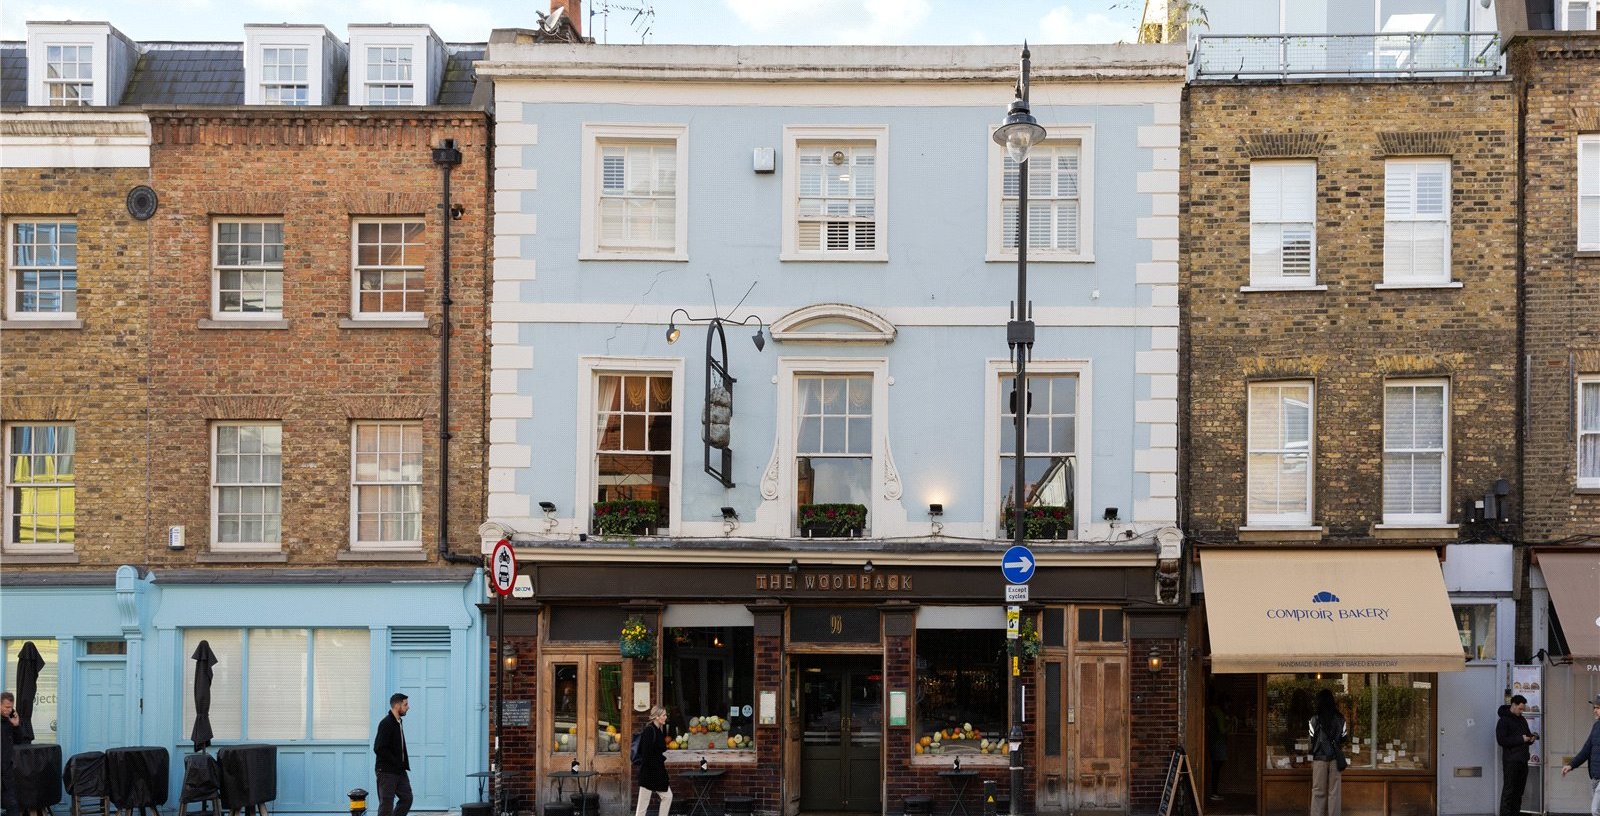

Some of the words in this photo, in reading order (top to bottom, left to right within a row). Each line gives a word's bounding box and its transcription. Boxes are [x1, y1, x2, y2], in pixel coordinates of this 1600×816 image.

[757, 575, 793, 589] THE
[805, 575, 912, 589] WOOLPACK
[1008, 586, 1027, 594] Except
[1339, 608, 1390, 621] BAKERY
[1278, 660, 1313, 668] HANDMADE
[1366, 659, 1398, 667] EVERYDAY
